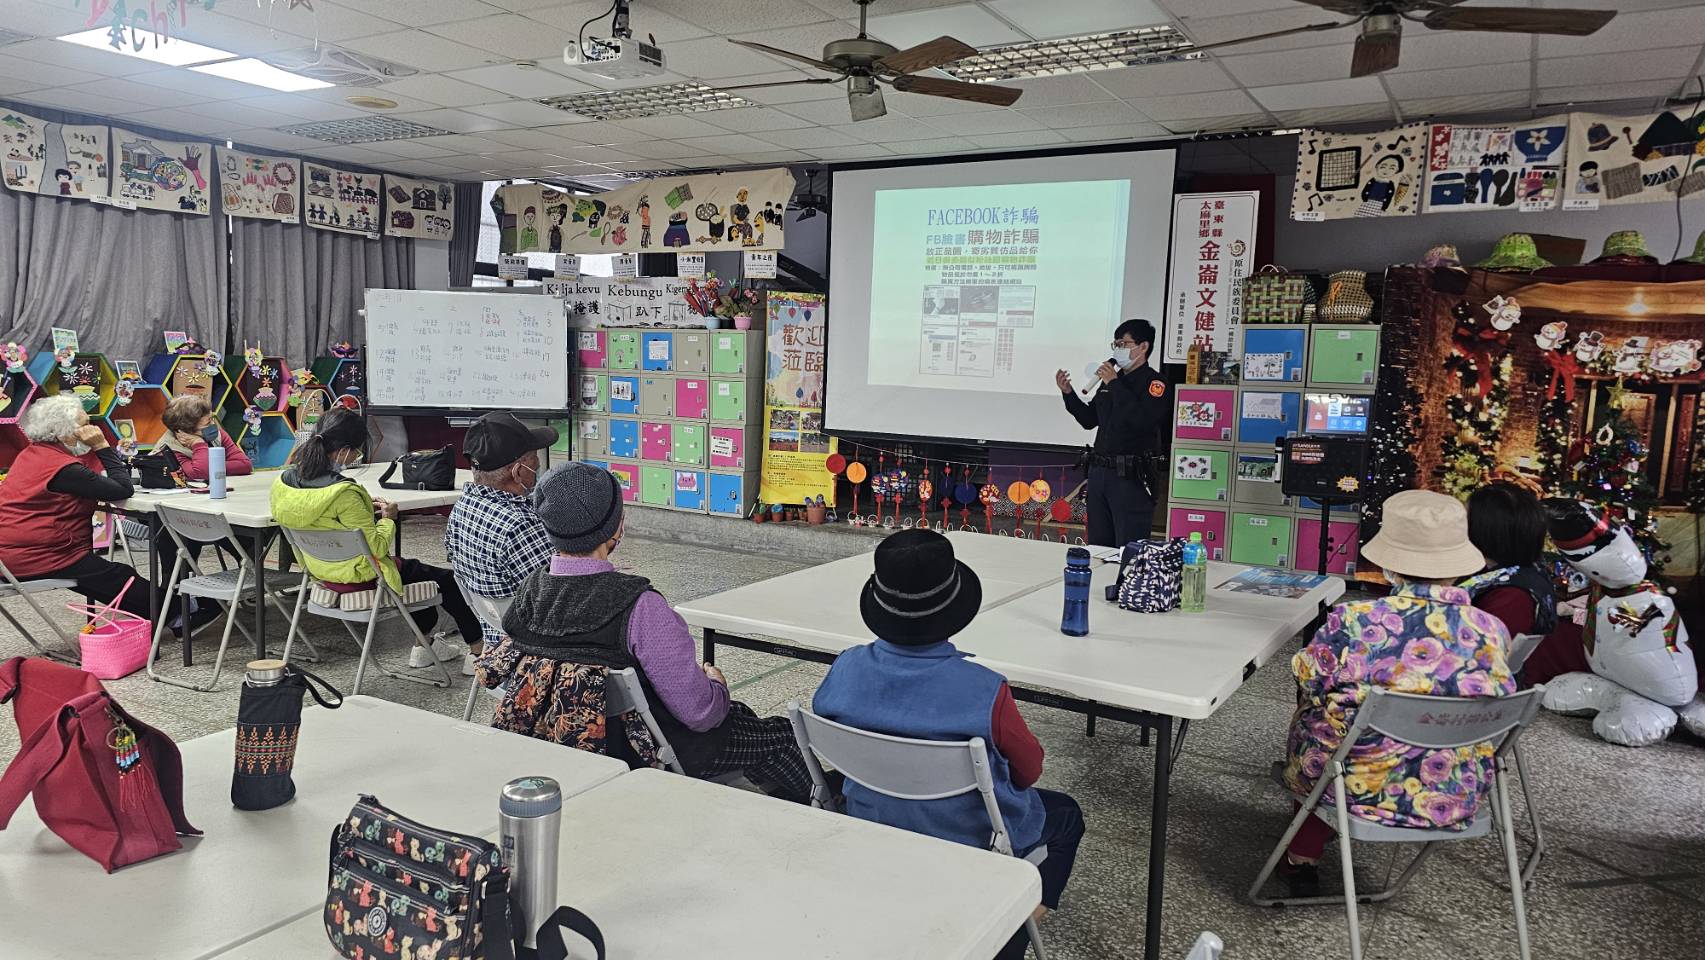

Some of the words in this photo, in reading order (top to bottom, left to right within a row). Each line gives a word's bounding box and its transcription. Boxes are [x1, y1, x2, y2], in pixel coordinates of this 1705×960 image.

[1197, 200, 1212, 239] 太麻里鄉
[1211, 200, 1225, 238] 臺東縣
[576, 283, 600, 293] kevu
[607, 284, 663, 301] Kebungu
[1230, 258, 1244, 325] 原住民族委員會
[574, 300, 600, 315] 掩護
[635, 305, 663, 320] 趴下
[783, 323, 825, 346] 歡迎
